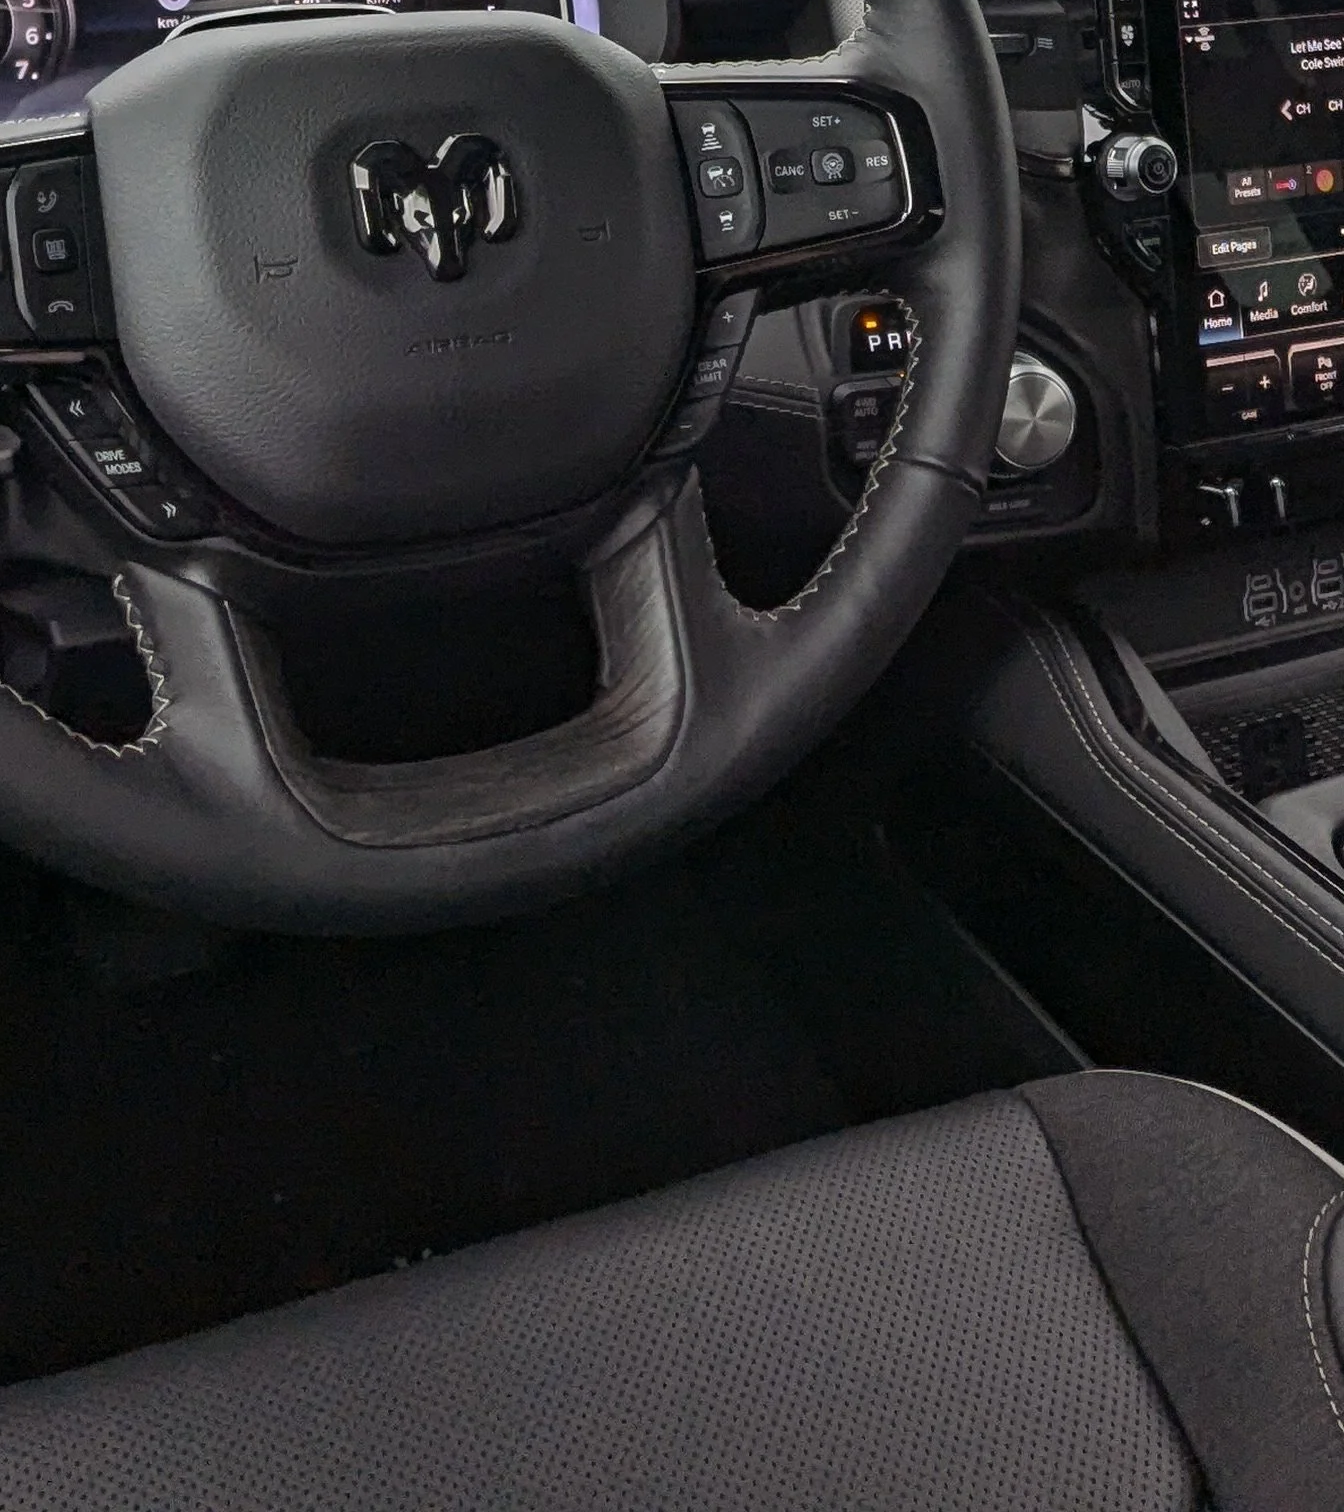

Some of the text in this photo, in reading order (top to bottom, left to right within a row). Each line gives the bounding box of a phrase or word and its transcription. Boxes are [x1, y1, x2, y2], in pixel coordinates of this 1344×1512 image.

[25, 28, 39, 45] 6
[1290, 40, 1306, 54] Let
[1307, 39, 1323, 52] Me
[1323, 39, 1342, 51] See
[15, 61, 29, 80] 7
[1301, 58, 1323, 71] Cole
[1296, 102, 1312, 116] CH
[1328, 99, 1344, 112] CH
[866, 155, 889, 168] RES
[774, 165, 805, 177] CANC
[1242, 176, 1252, 187] All
[1234, 188, 1262, 199] Presets
[1212, 241, 1257, 255] Edit Pages
[1291, 300, 1328, 316] Comfort
[1250, 309, 1279, 322] Media
[1204, 317, 1233, 330] Home
[868, 333, 882, 352] P
[887, 332, 903, 350] R
[699, 357, 728, 370] GEAR
[95, 449, 126, 462] DRIVE
[104, 461, 142, 476] MODES
